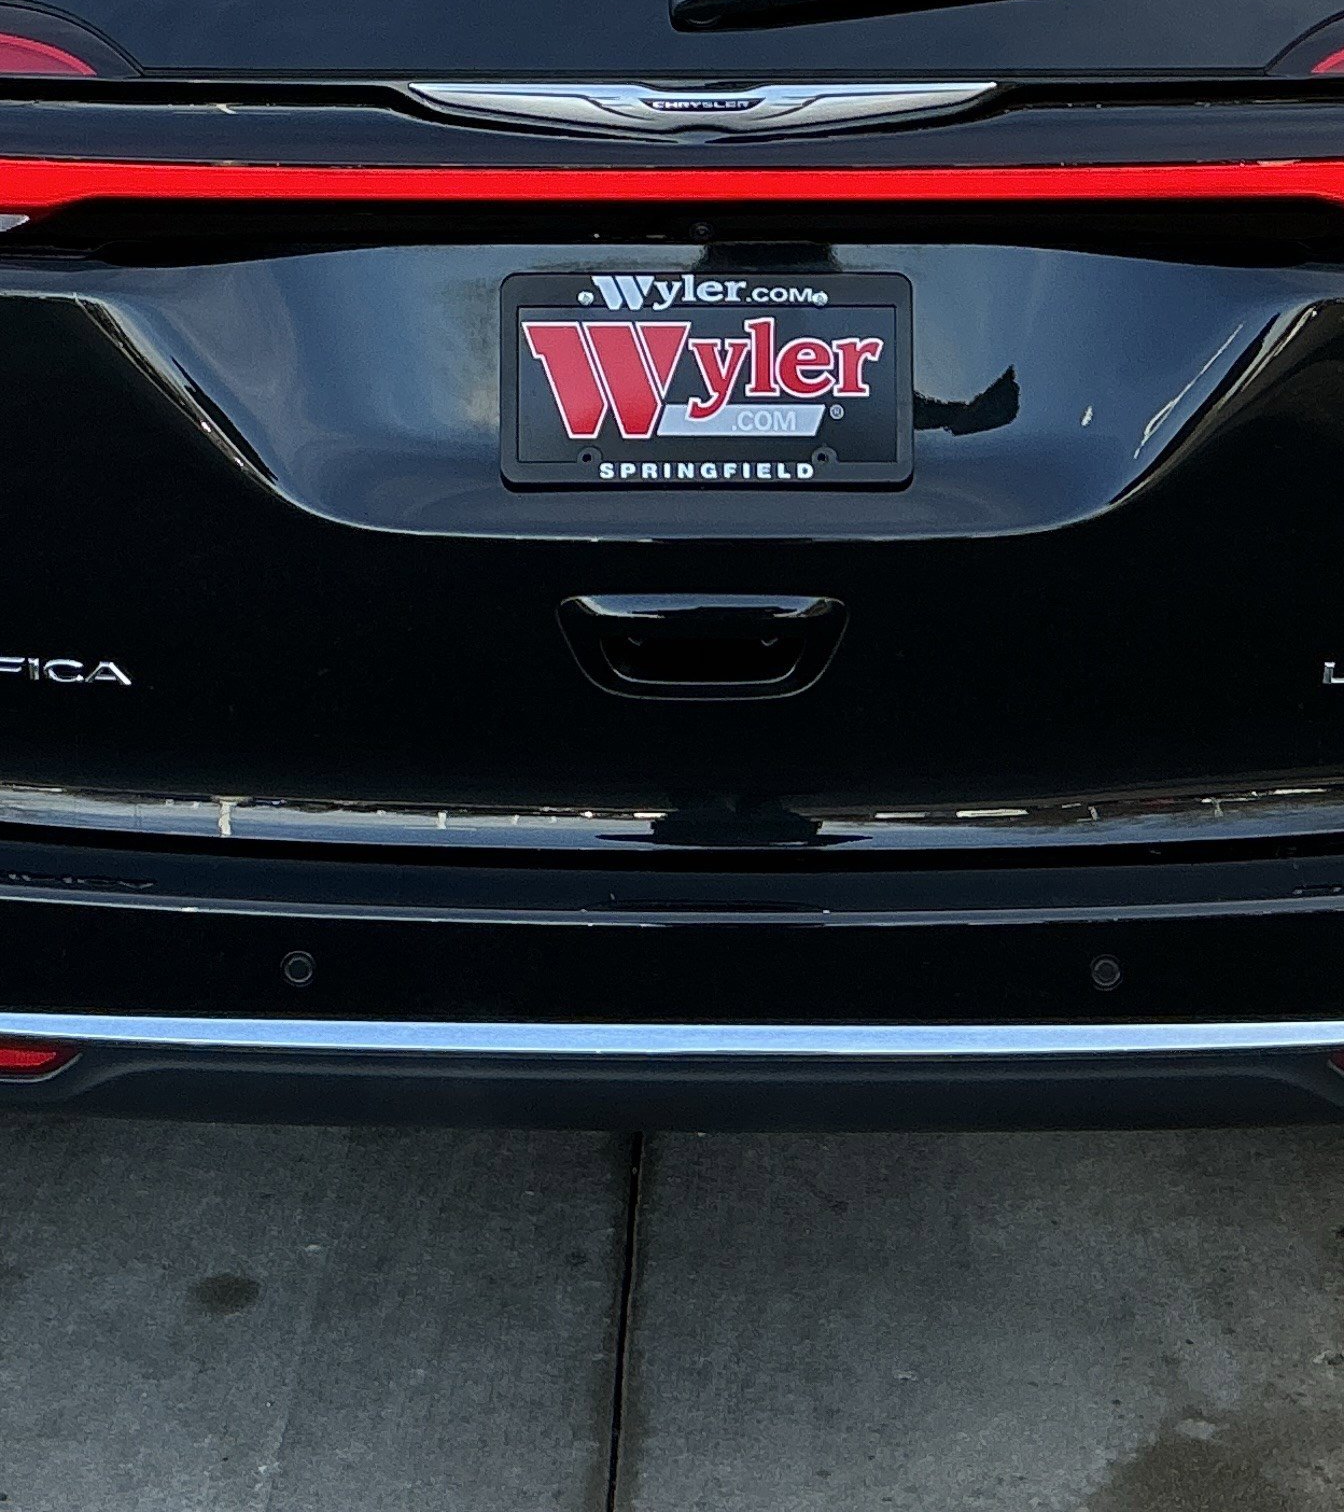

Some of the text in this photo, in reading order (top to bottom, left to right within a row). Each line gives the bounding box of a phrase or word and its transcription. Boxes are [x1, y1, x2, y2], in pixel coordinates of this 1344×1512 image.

[652, 100, 750, 109] CHRYSLER
[522, 317, 884, 439] Wyler
[730, 410, 797, 431] .COM
[598, 462, 814, 479] SPRINGFIELD
